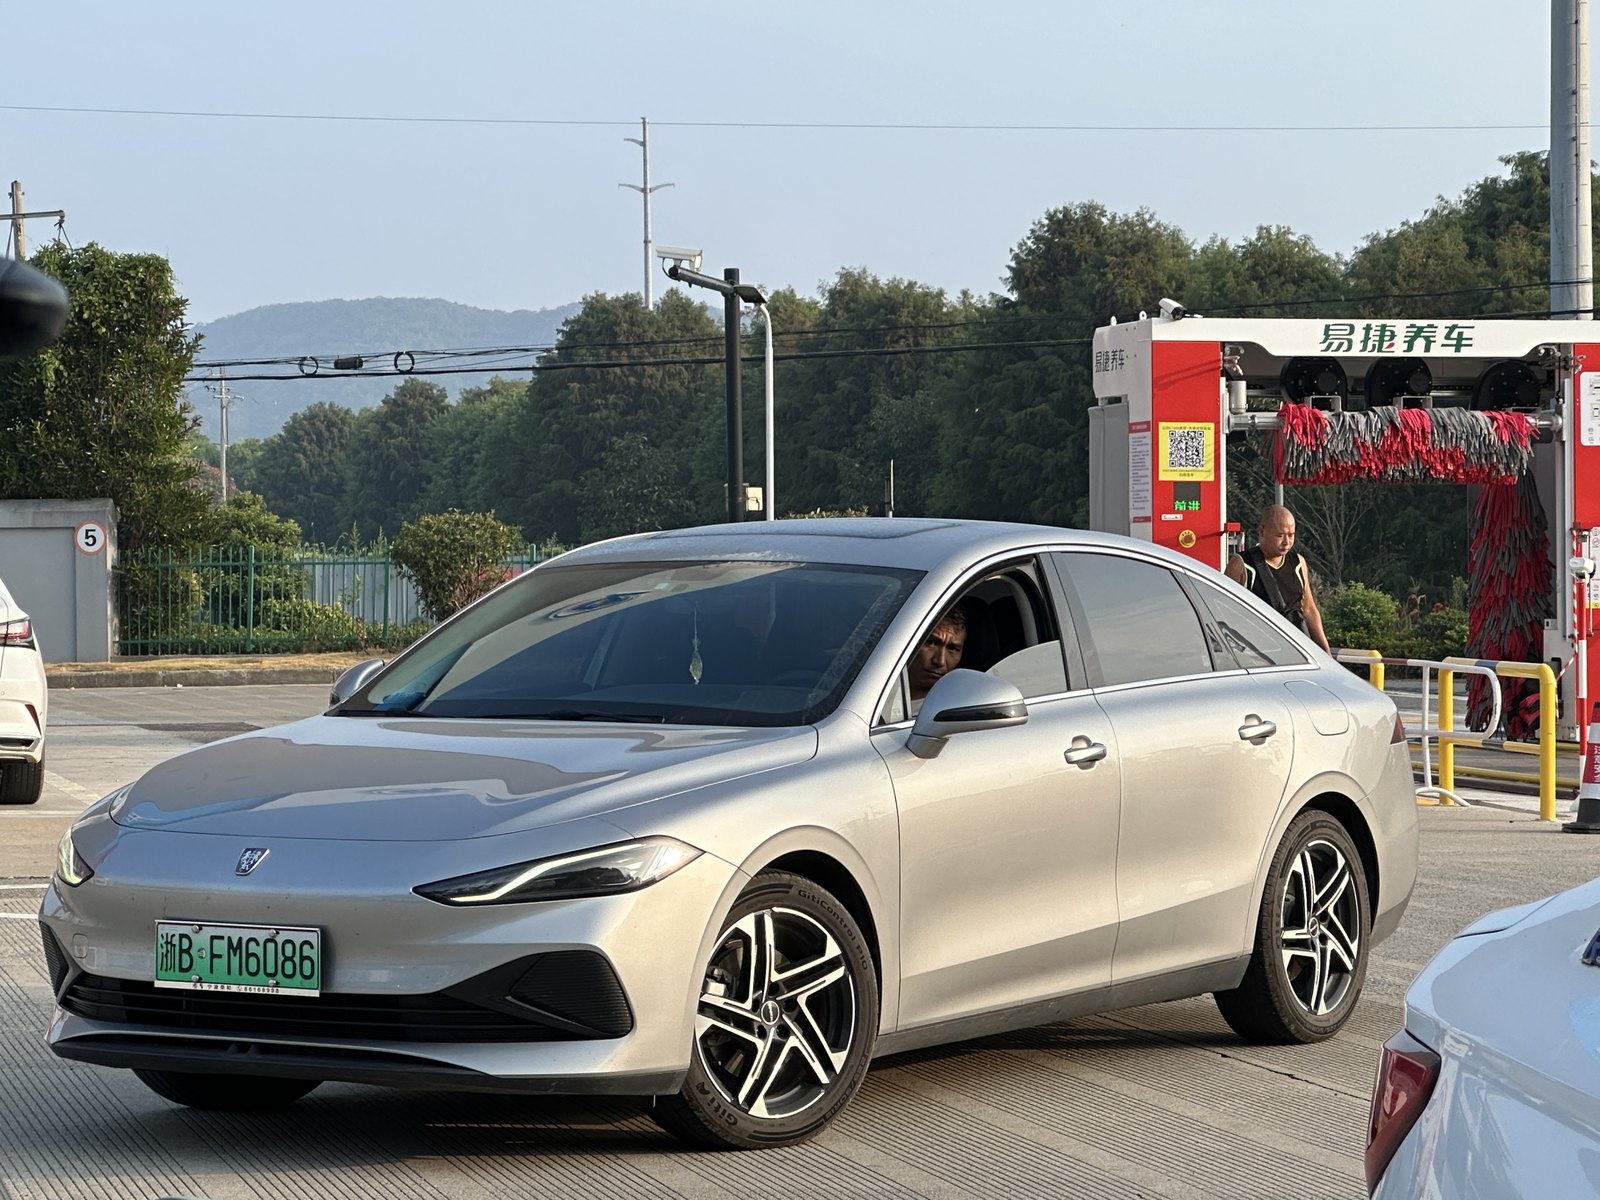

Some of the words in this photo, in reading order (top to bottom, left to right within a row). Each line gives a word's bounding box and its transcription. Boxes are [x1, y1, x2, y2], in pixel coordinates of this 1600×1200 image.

[1319, 323, 1475, 353] 易捷养车
[1095, 348, 1125, 373] 易捷养车
[84, 528, 97, 547] 5
[798, 889, 857, 941] GitiControl
[856, 944, 868, 971] P10
[706, 1096, 738, 1126] Giti
